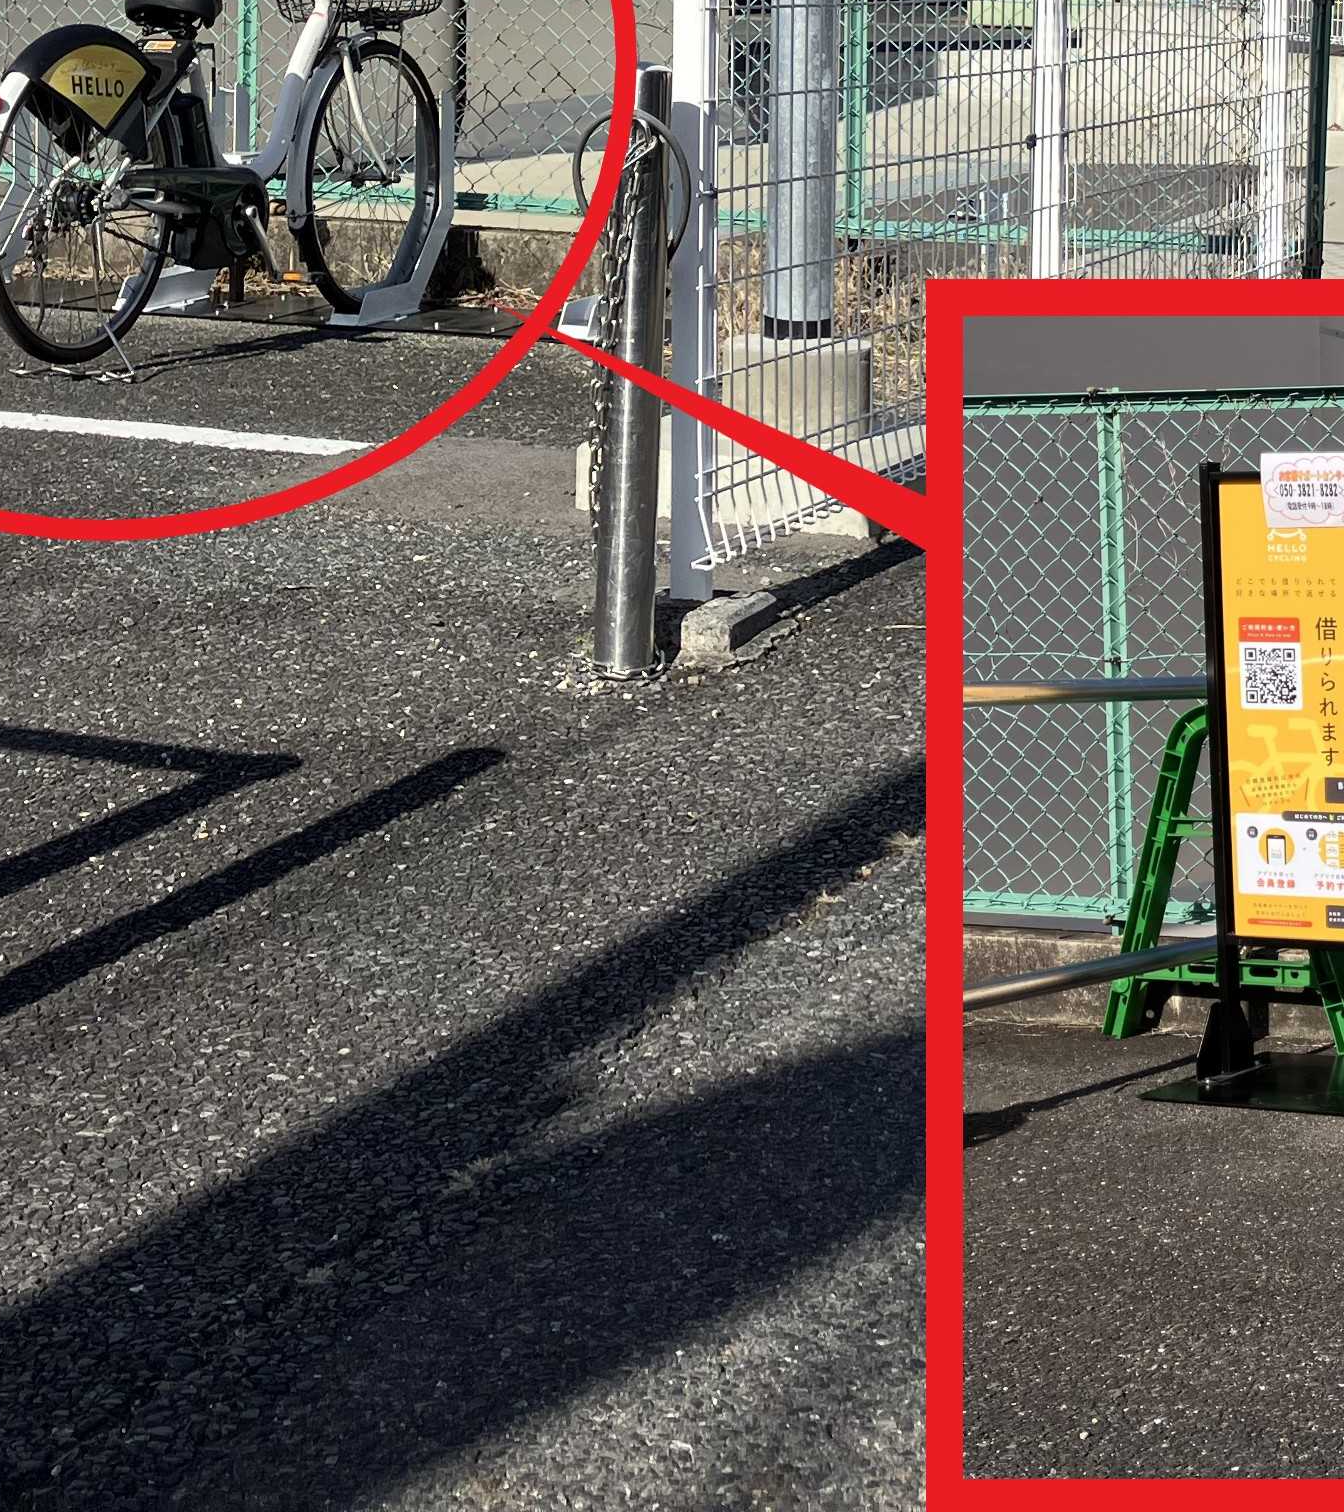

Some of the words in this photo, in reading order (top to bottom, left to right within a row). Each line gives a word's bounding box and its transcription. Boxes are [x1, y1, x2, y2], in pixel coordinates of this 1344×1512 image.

[71, 75, 125, 98] HELLO
[1267, 543, 1307, 553] HELLO
[1315, 617, 1340, 767] 借りられます
